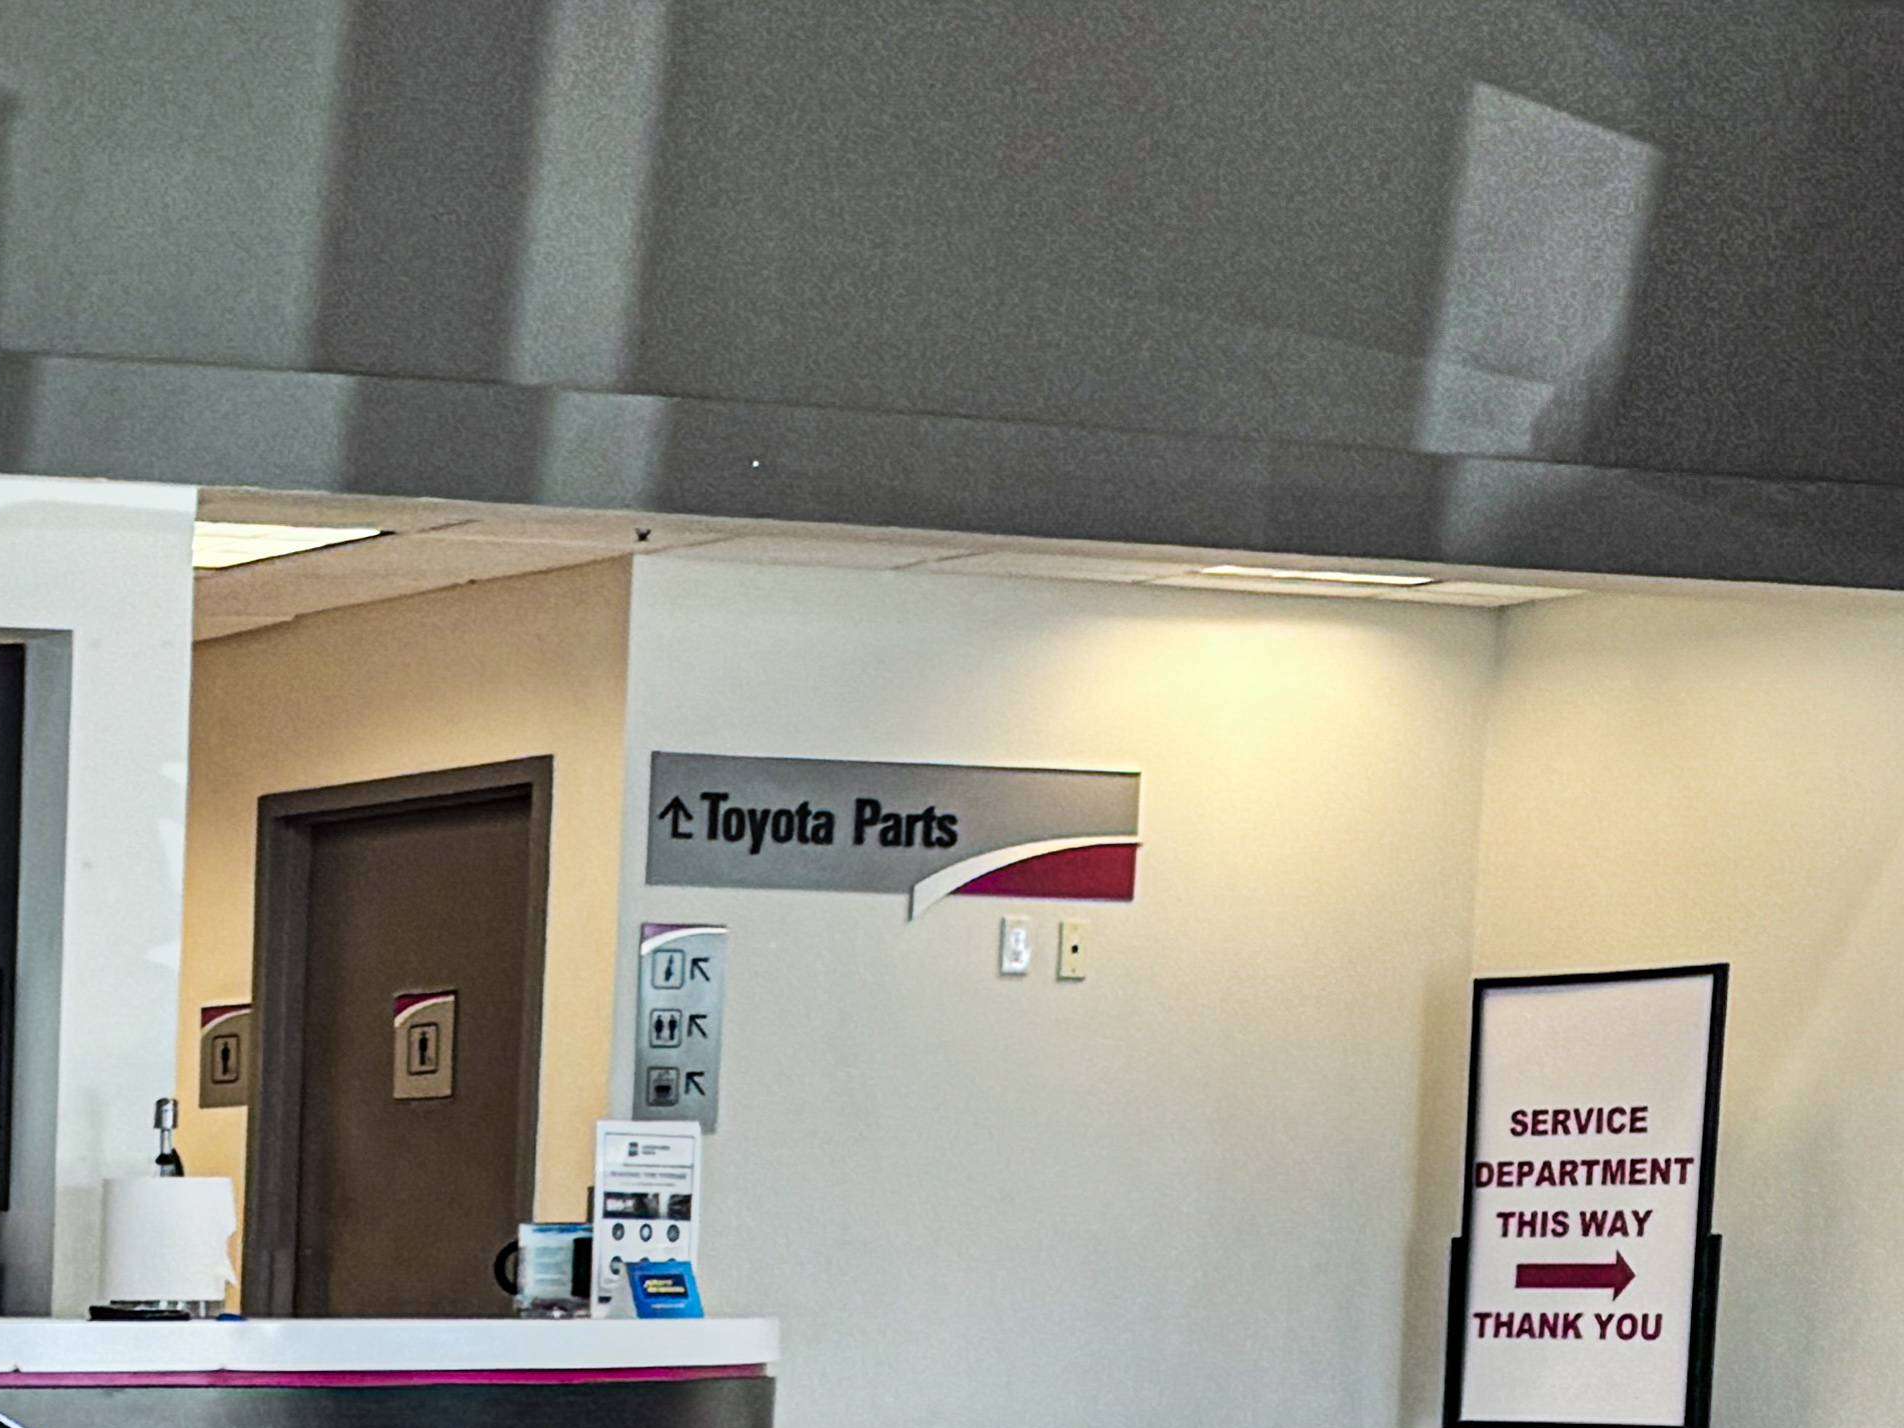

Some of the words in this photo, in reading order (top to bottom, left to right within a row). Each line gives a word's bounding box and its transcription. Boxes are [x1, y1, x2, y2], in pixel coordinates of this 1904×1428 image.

[700, 792, 835, 855] Toyota
[853, 797, 959, 849] Parts
[1509, 1106, 1649, 1136] SERVICE
[1475, 1157, 1694, 1188] DEPARTMENT
[1496, 1210, 1570, 1238] THIS
[1579, 1209, 1653, 1238] WAY
[1473, 1312, 1584, 1339] THANK
[1594, 1313, 1663, 1341] YOU
